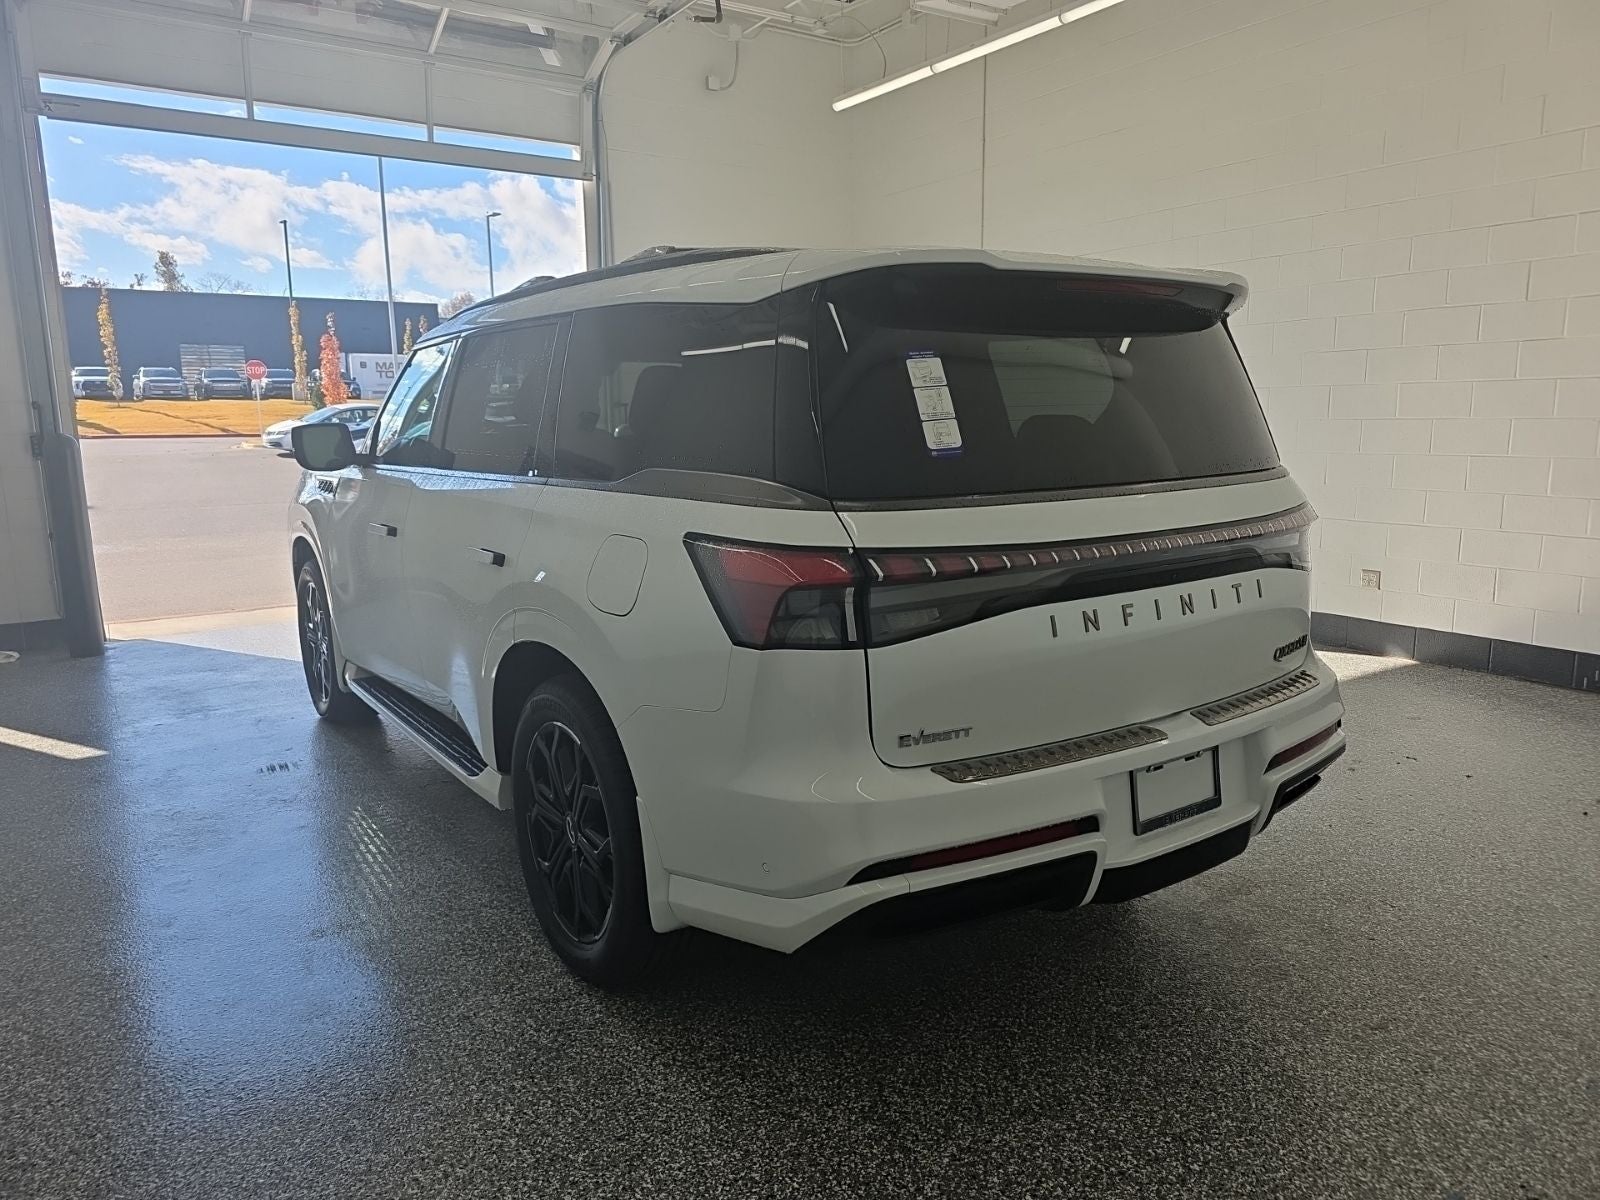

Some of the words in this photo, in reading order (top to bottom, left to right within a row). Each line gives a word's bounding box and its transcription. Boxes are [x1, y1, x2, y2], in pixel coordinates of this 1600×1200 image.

[246, 366, 265, 375] STOP
[1050, 578, 1263, 638] INFINITI
[897, 727, 973, 749] EVERETT
